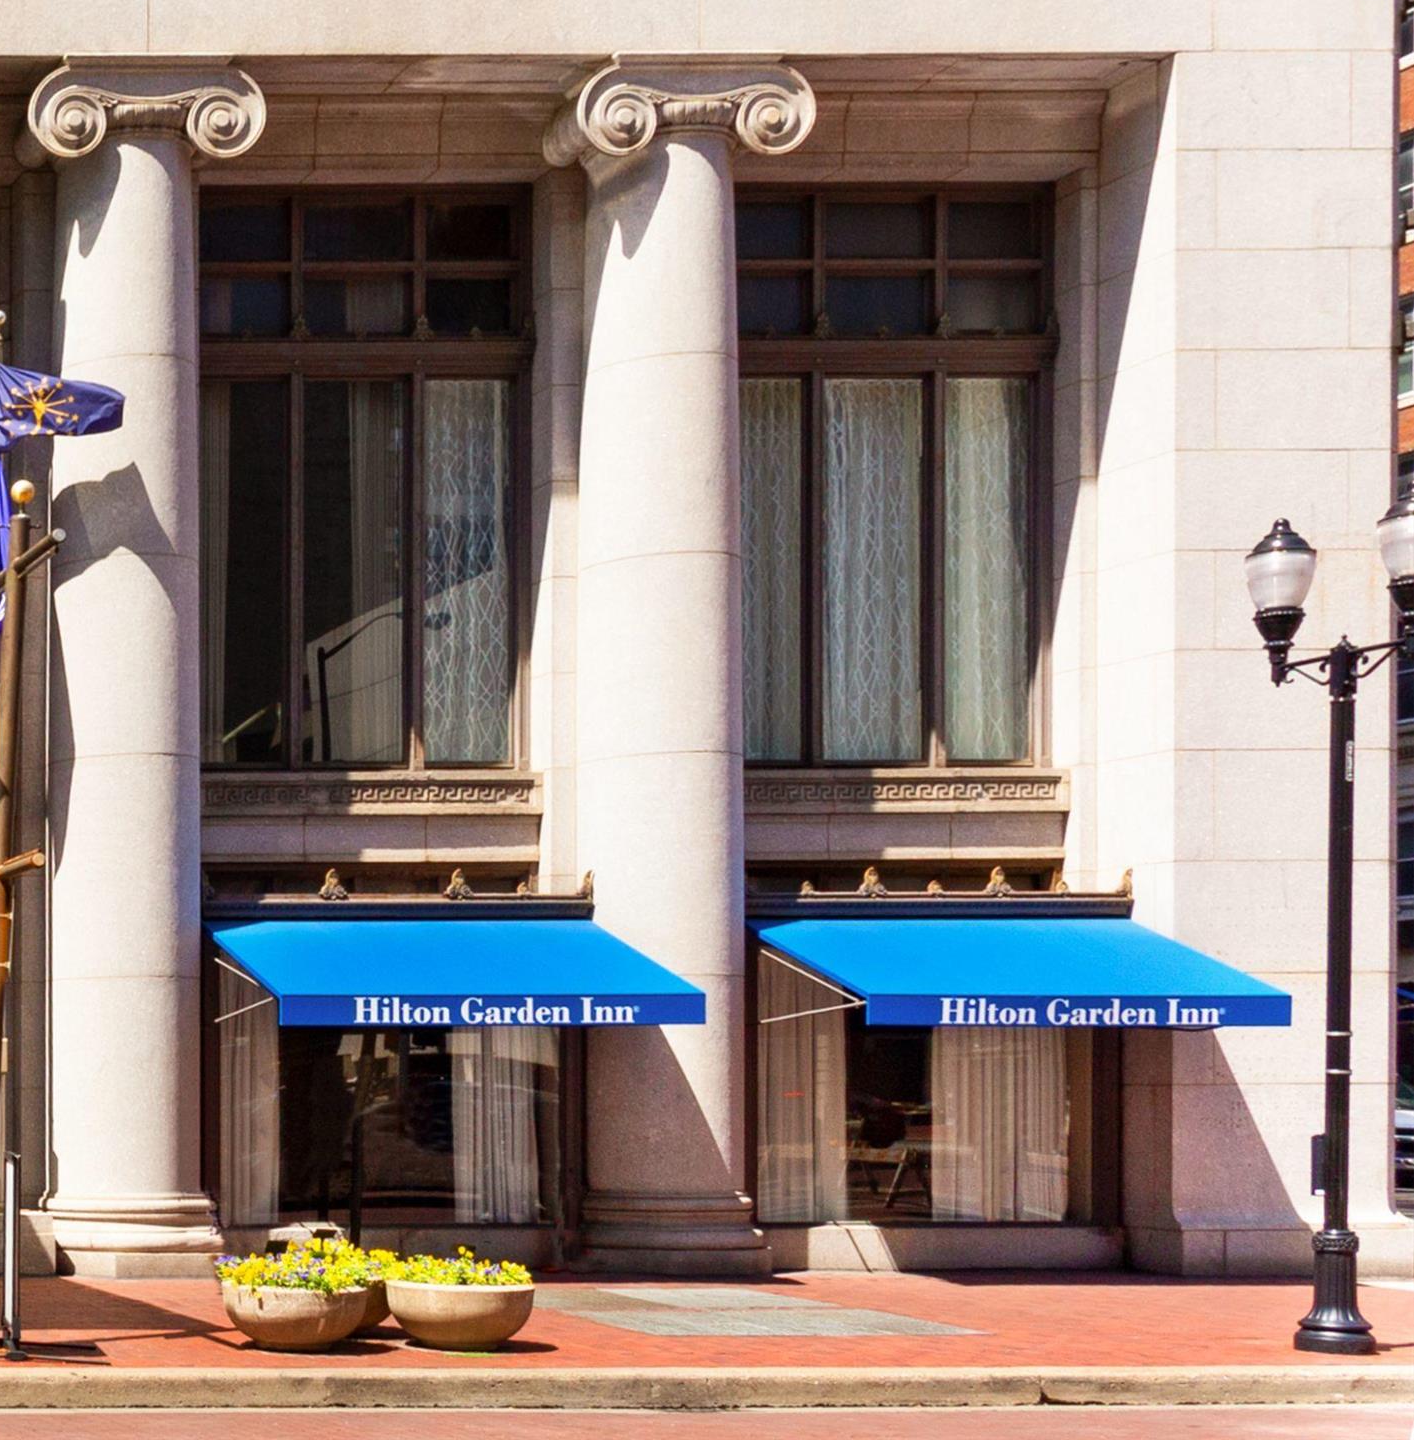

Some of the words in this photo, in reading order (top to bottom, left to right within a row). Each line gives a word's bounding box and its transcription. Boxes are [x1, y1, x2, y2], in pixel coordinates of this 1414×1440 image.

[353, 996, 451, 1024] Hilton
[460, 996, 571, 1024] Garden
[580, 996, 634, 1024] Inn
[939, 997, 1036, 1025] Hilton
[1046, 997, 1157, 1026] Garden
[1166, 998, 1220, 1025] Inn
